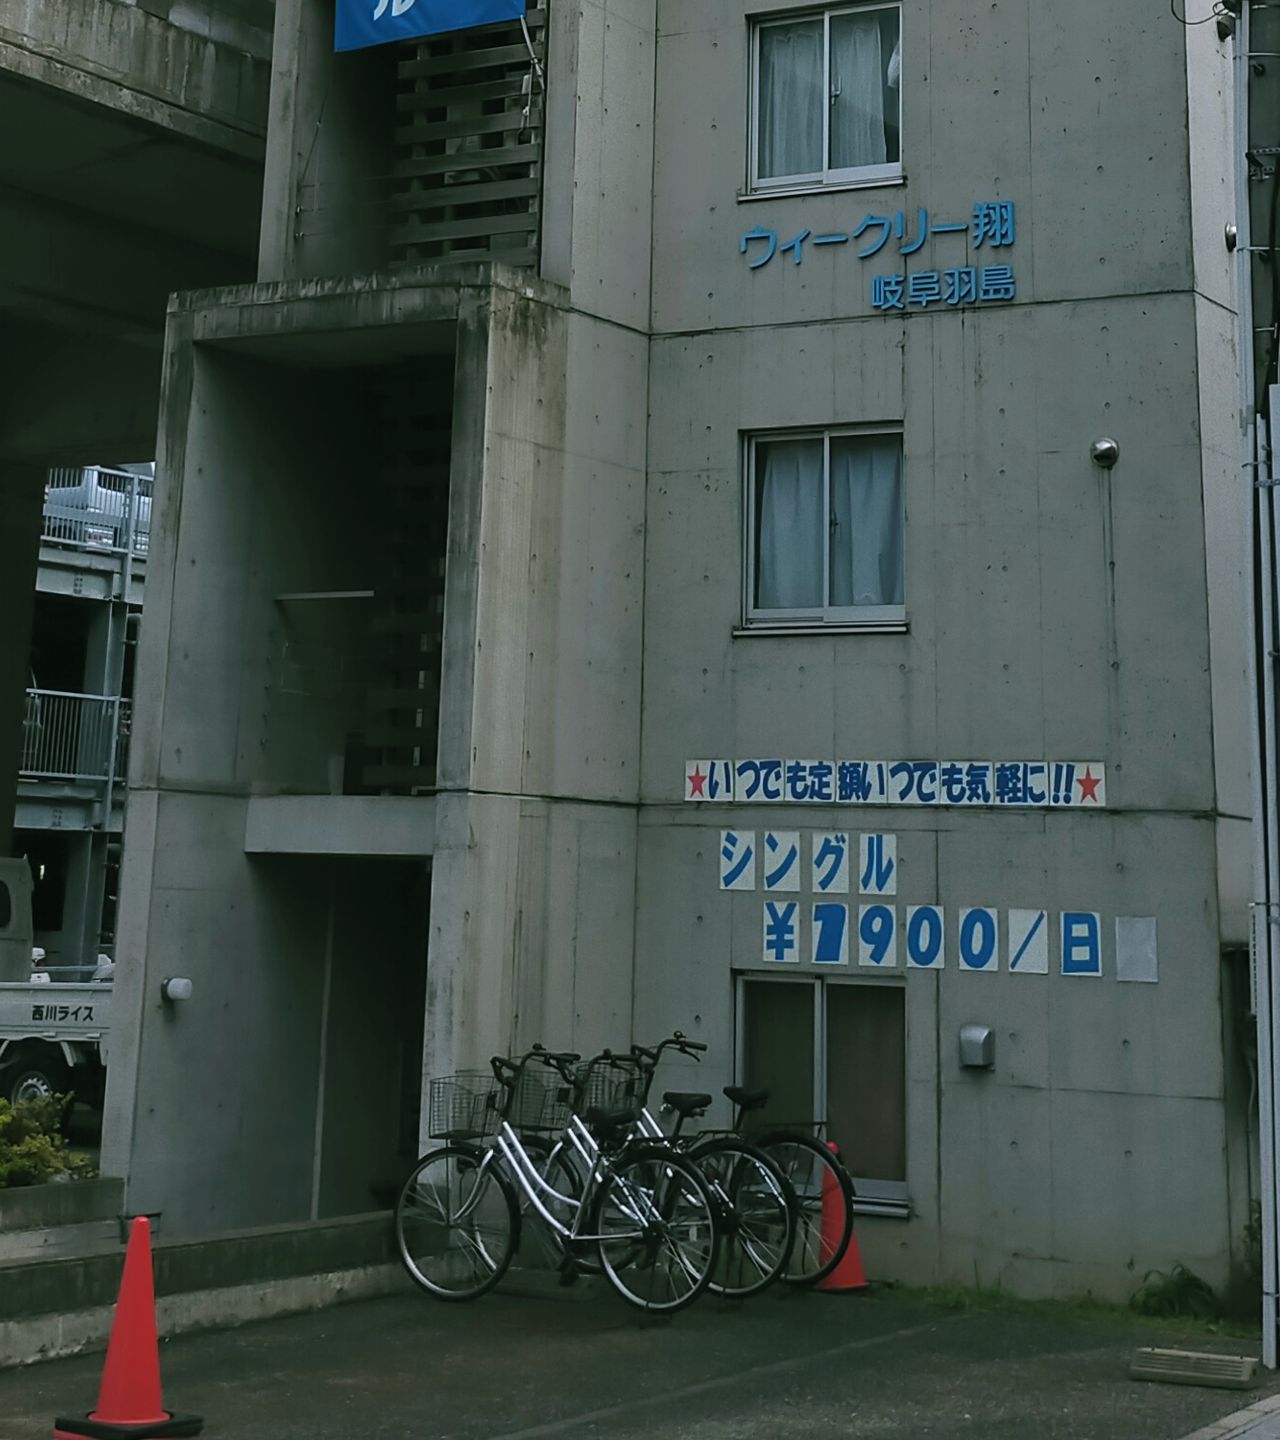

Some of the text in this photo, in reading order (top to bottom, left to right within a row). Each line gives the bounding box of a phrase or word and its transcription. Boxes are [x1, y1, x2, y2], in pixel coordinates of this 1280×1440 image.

[739, 200, 1016, 270] ウィークリー翔
[871, 264, 1016, 310] 岐阜羽島
[721, 830, 895, 893] シングル
[765, 901, 1099, 973] ¥1900/日
[31, 1005, 94, 1021] 西川ライス
